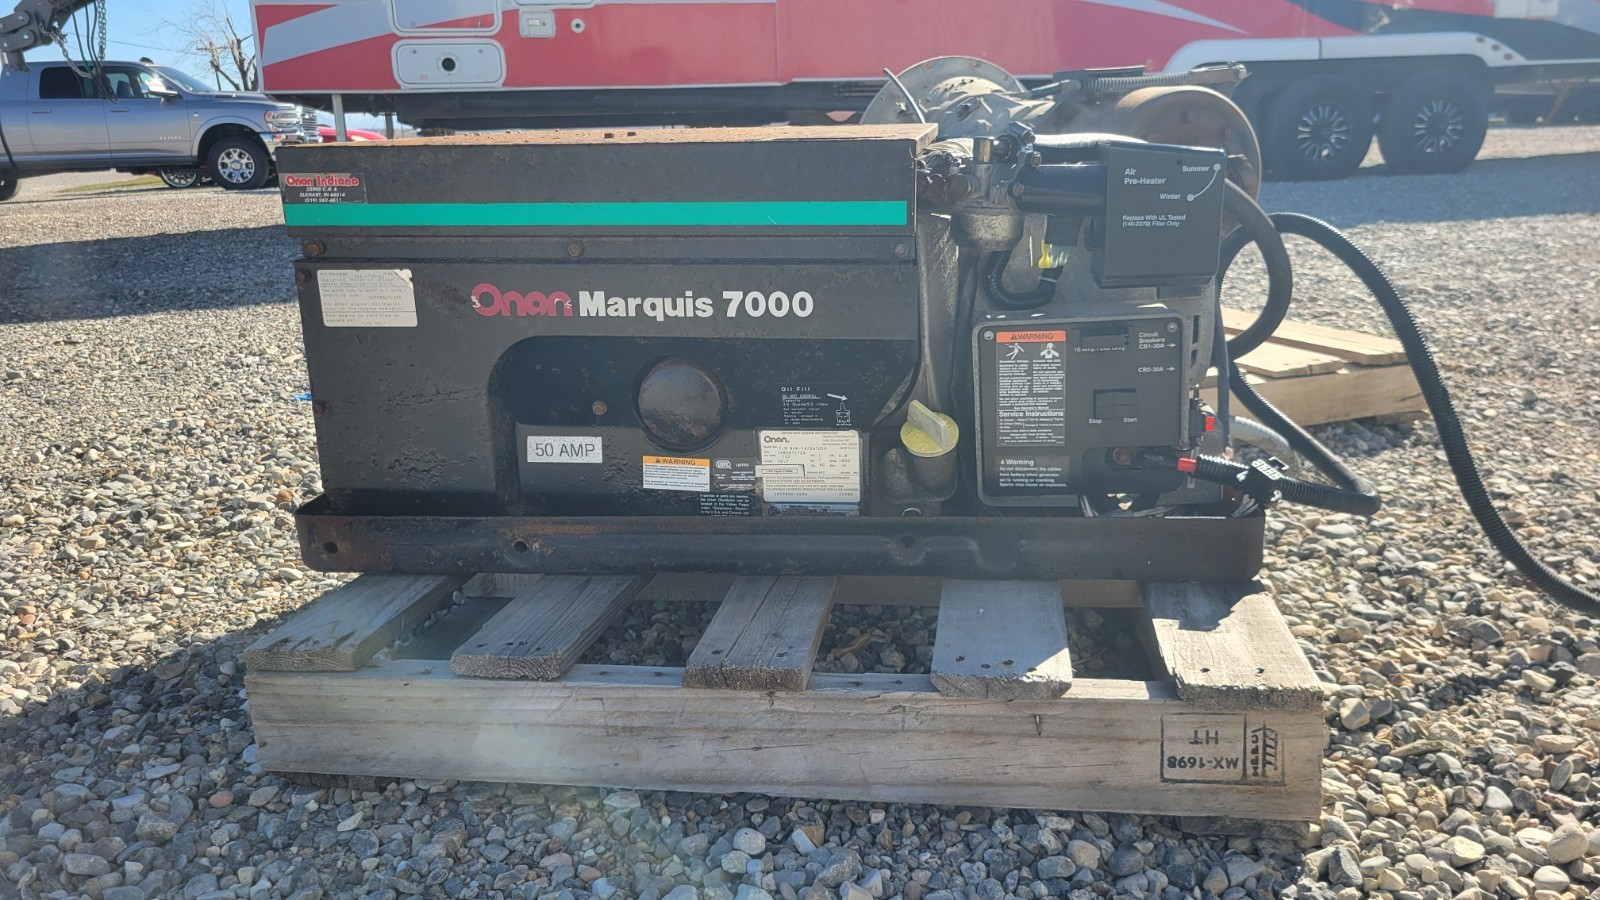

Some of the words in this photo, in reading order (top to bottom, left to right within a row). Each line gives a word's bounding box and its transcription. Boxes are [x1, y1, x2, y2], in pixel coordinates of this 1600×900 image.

[285, 175, 314, 186] Onan
[316, 175, 359, 186] Indiana
[1124, 177, 1166, 185] Pre-Heater
[471, 283, 573, 317] Onan
[579, 291, 714, 322] Marquis
[723, 291, 814, 318] 7000
[535, 443, 556, 457] 50
[559, 443, 595, 457] AMP
[1189, 730, 1219, 745] HT
